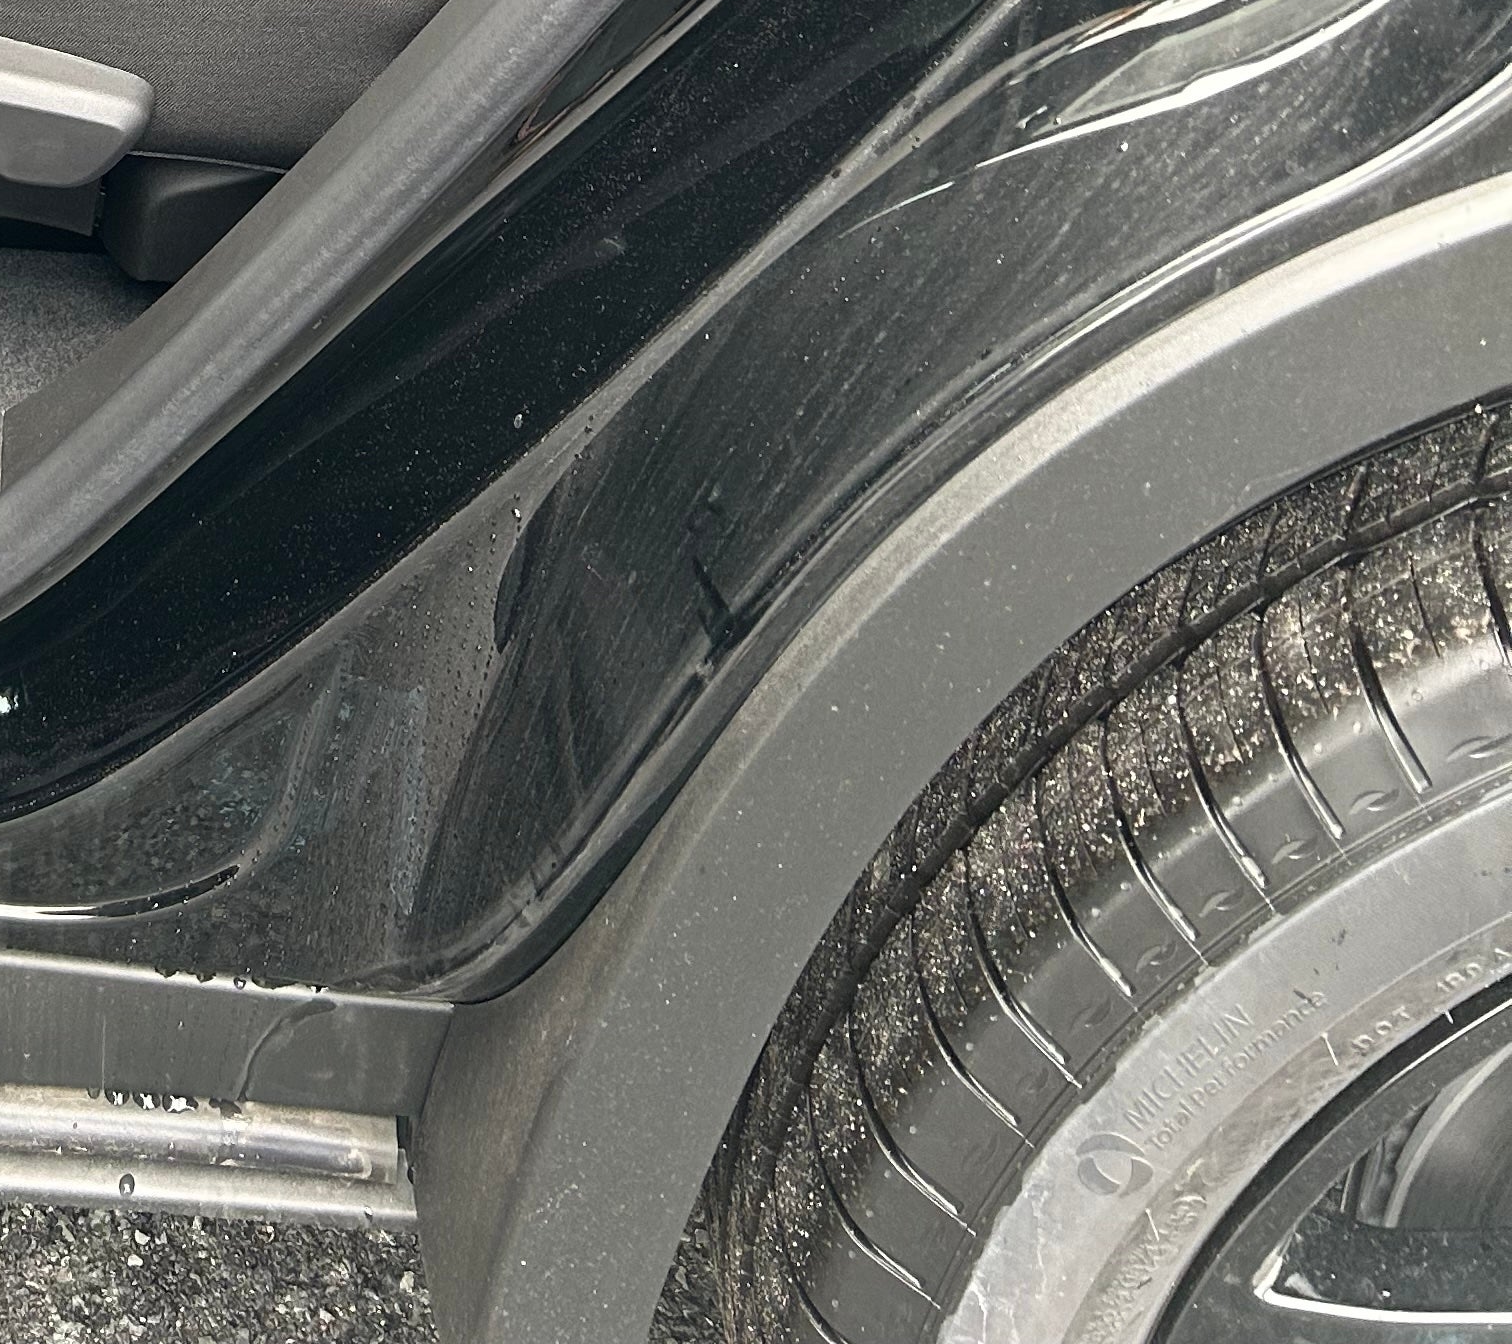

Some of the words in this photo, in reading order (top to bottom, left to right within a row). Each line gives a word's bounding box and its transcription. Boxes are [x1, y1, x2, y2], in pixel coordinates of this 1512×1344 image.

[1123, 1003, 1255, 1131] MICHELIN
[1144, 1097, 1195, 1151] Total
[1190, 991, 1328, 1109] Performance
